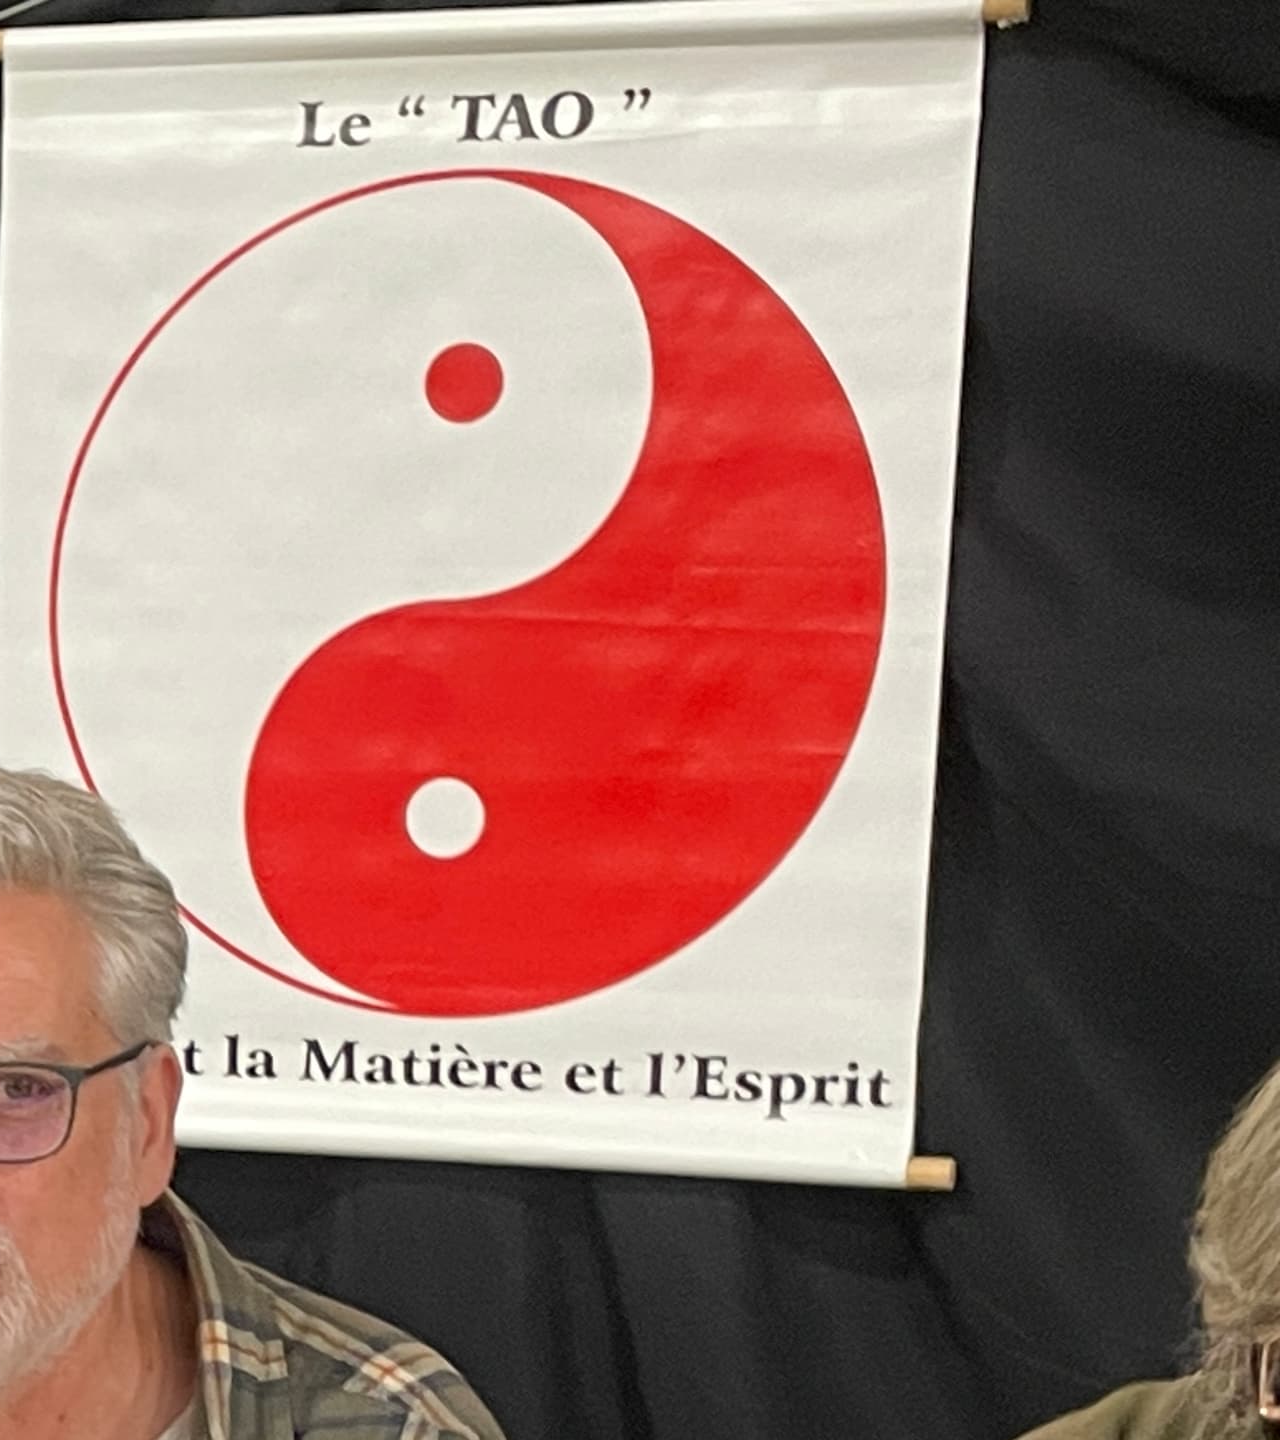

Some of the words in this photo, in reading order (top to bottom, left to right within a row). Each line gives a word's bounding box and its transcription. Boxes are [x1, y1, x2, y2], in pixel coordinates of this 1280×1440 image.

[295, 99, 372, 148] Le
[222, 1033, 278, 1079] la
[298, 1037, 544, 1092] Matière
[564, 1057, 625, 1096] et
